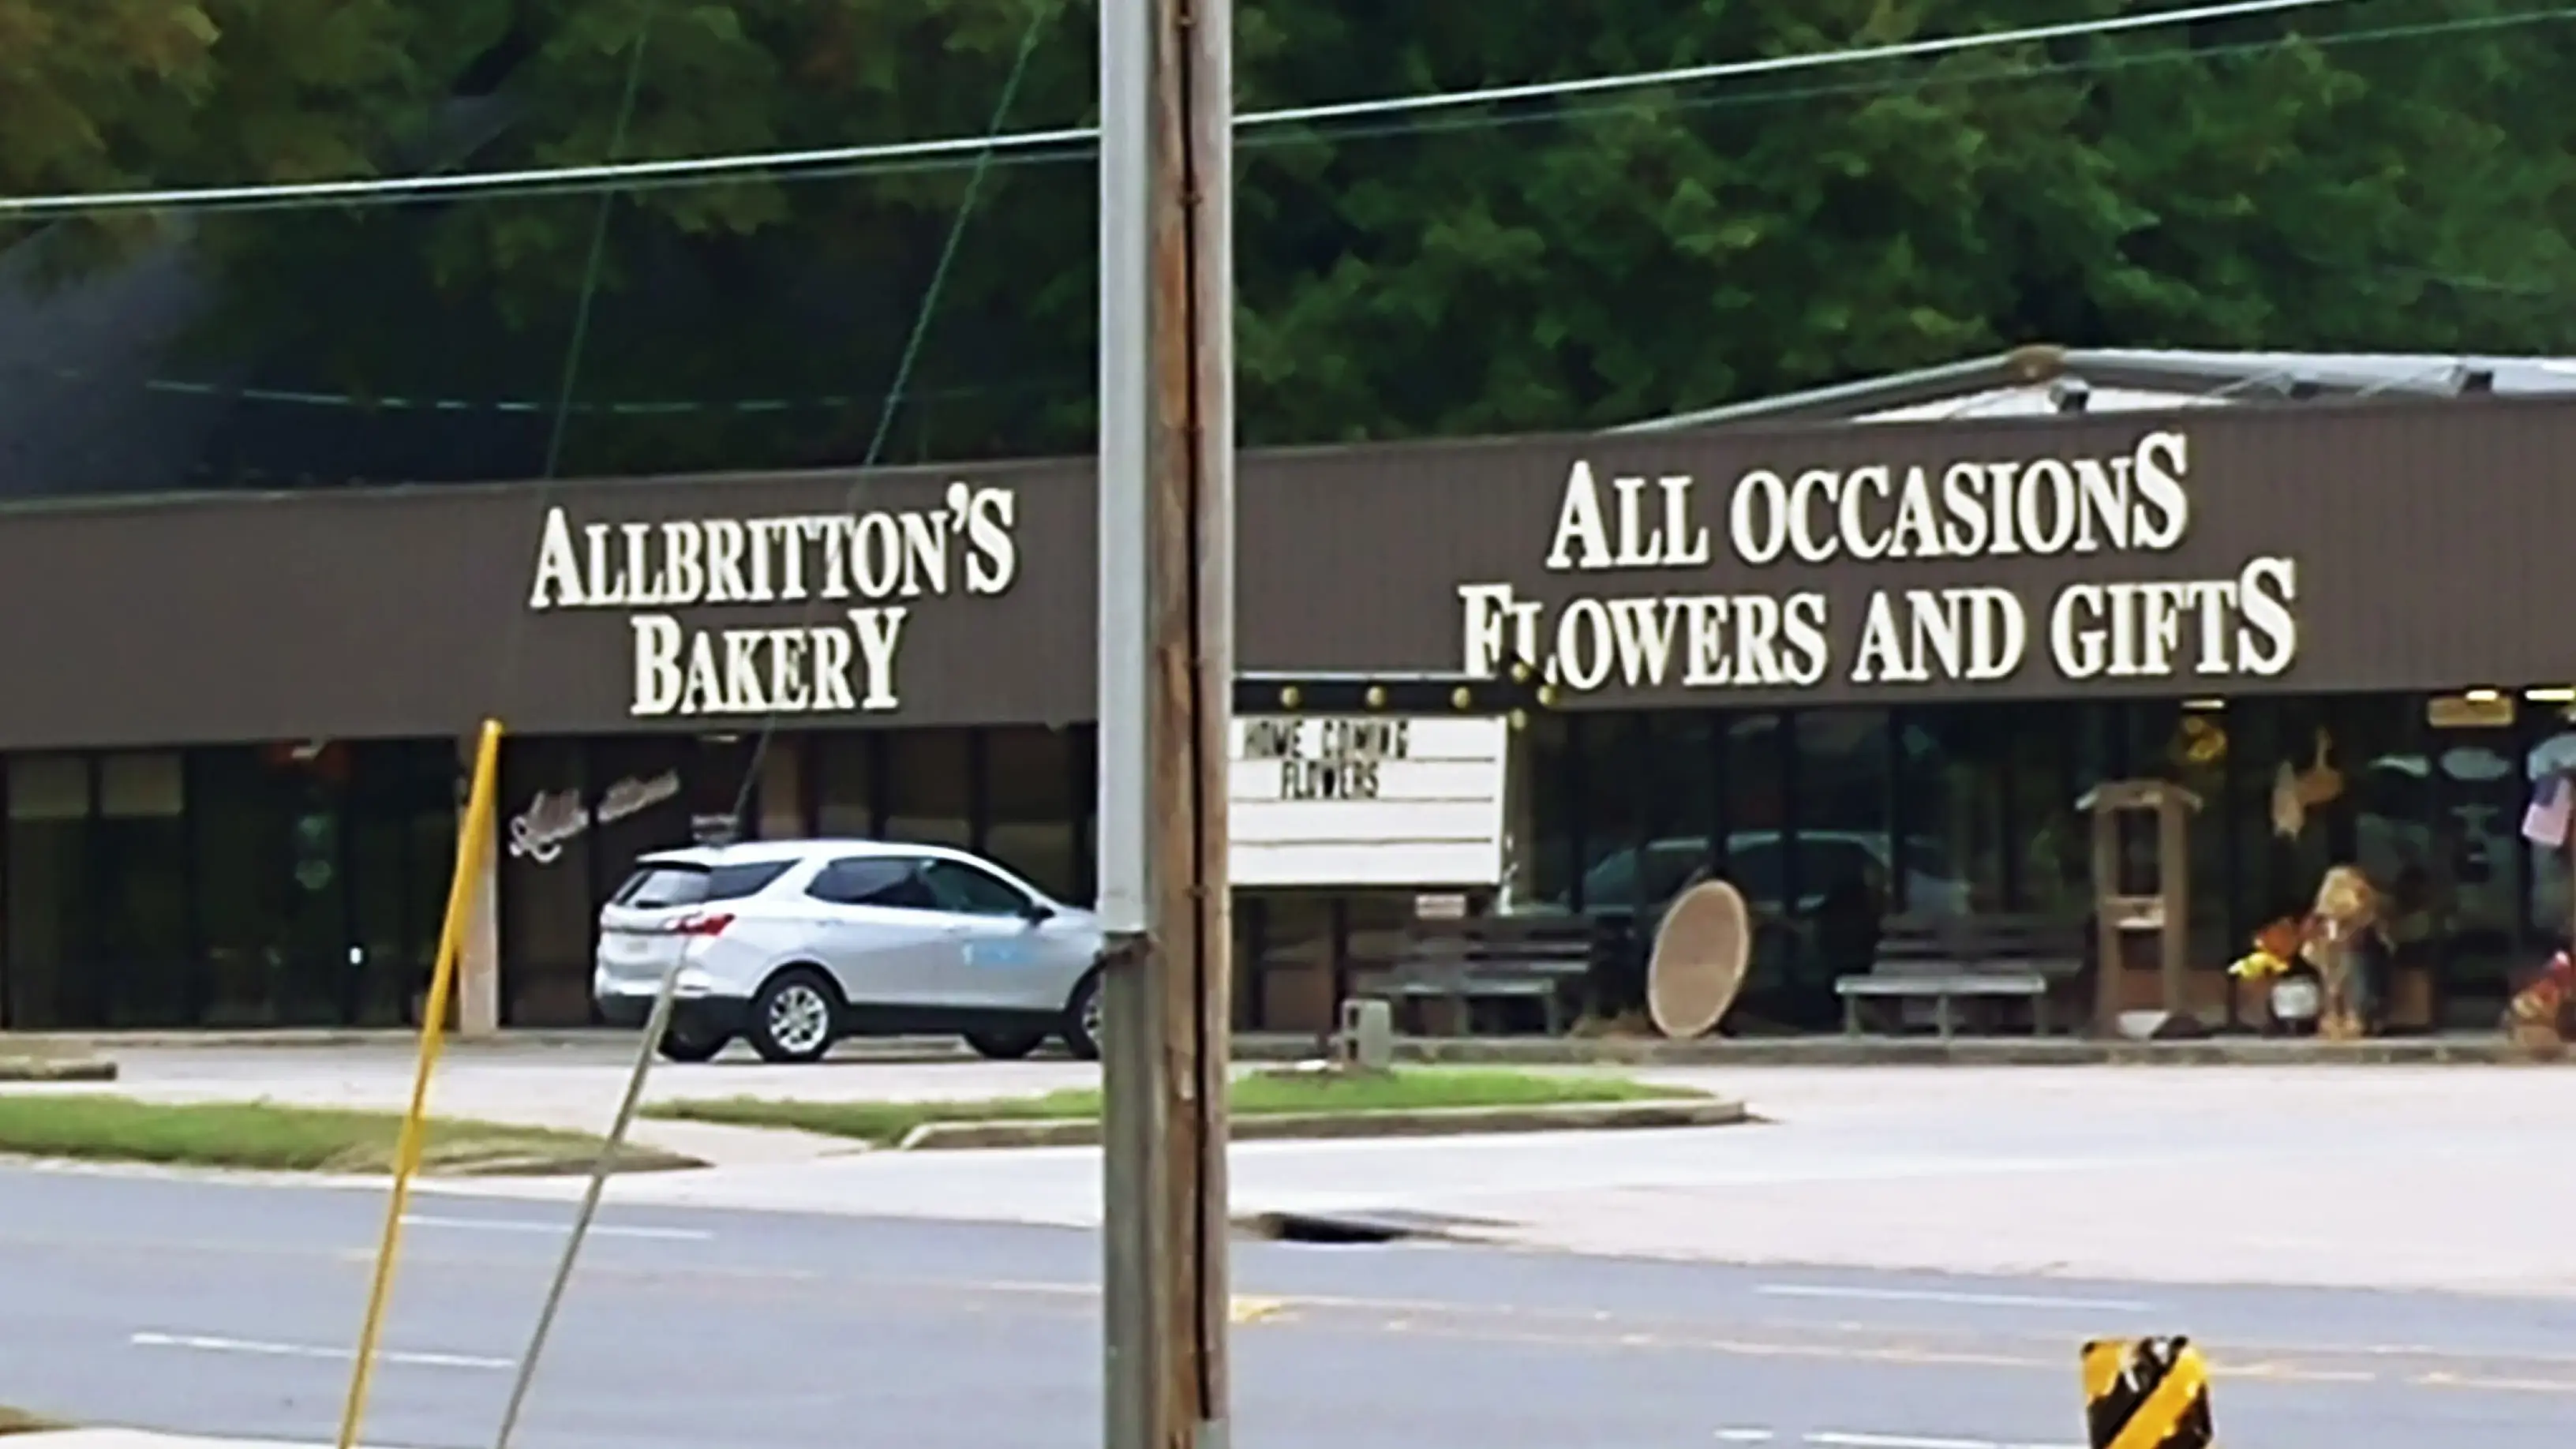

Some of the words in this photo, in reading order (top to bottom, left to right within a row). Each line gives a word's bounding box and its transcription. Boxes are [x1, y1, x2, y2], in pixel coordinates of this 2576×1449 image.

[530, 482, 1015, 608] ALLBRITTON'S
[1546, 460, 1709, 568] ALL
[1731, 432, 2188, 563] OCCASIONS
[631, 607, 907, 715] BAKERY
[1458, 583, 1829, 690] FLOWERS
[1852, 587, 2026, 682] AND
[2051, 556, 2296, 677] GIFTS
